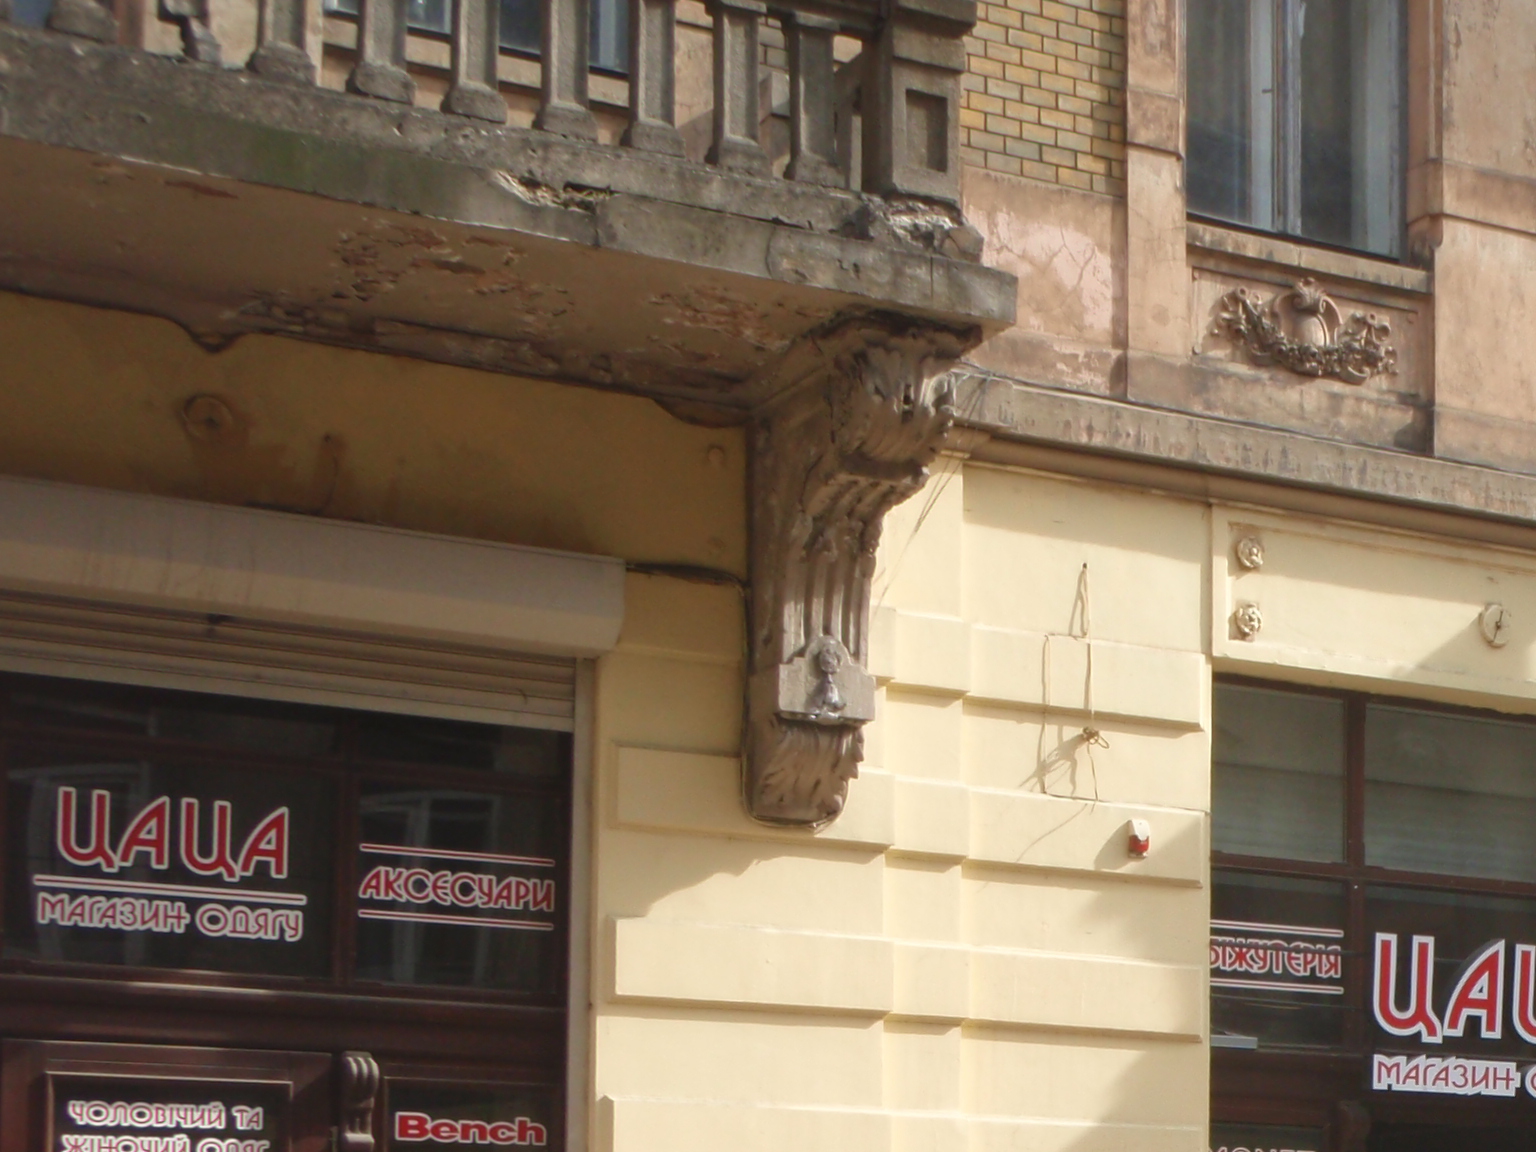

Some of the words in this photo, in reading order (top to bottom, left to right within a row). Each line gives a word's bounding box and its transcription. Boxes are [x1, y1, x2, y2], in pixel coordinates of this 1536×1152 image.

[58, 786, 289, 882] ЦАЦА
[37, 892, 190, 934] МАГАЗИН
[196, 903, 304, 942] ОДЯГУ
[1372, 1054, 1521, 1097] МАГАЗИН
[68, 1100, 227, 1129] ЧОЛОВІЧИЙ
[233, 1106, 263, 1131] ТА
[395, 1112, 547, 1146] Bench
